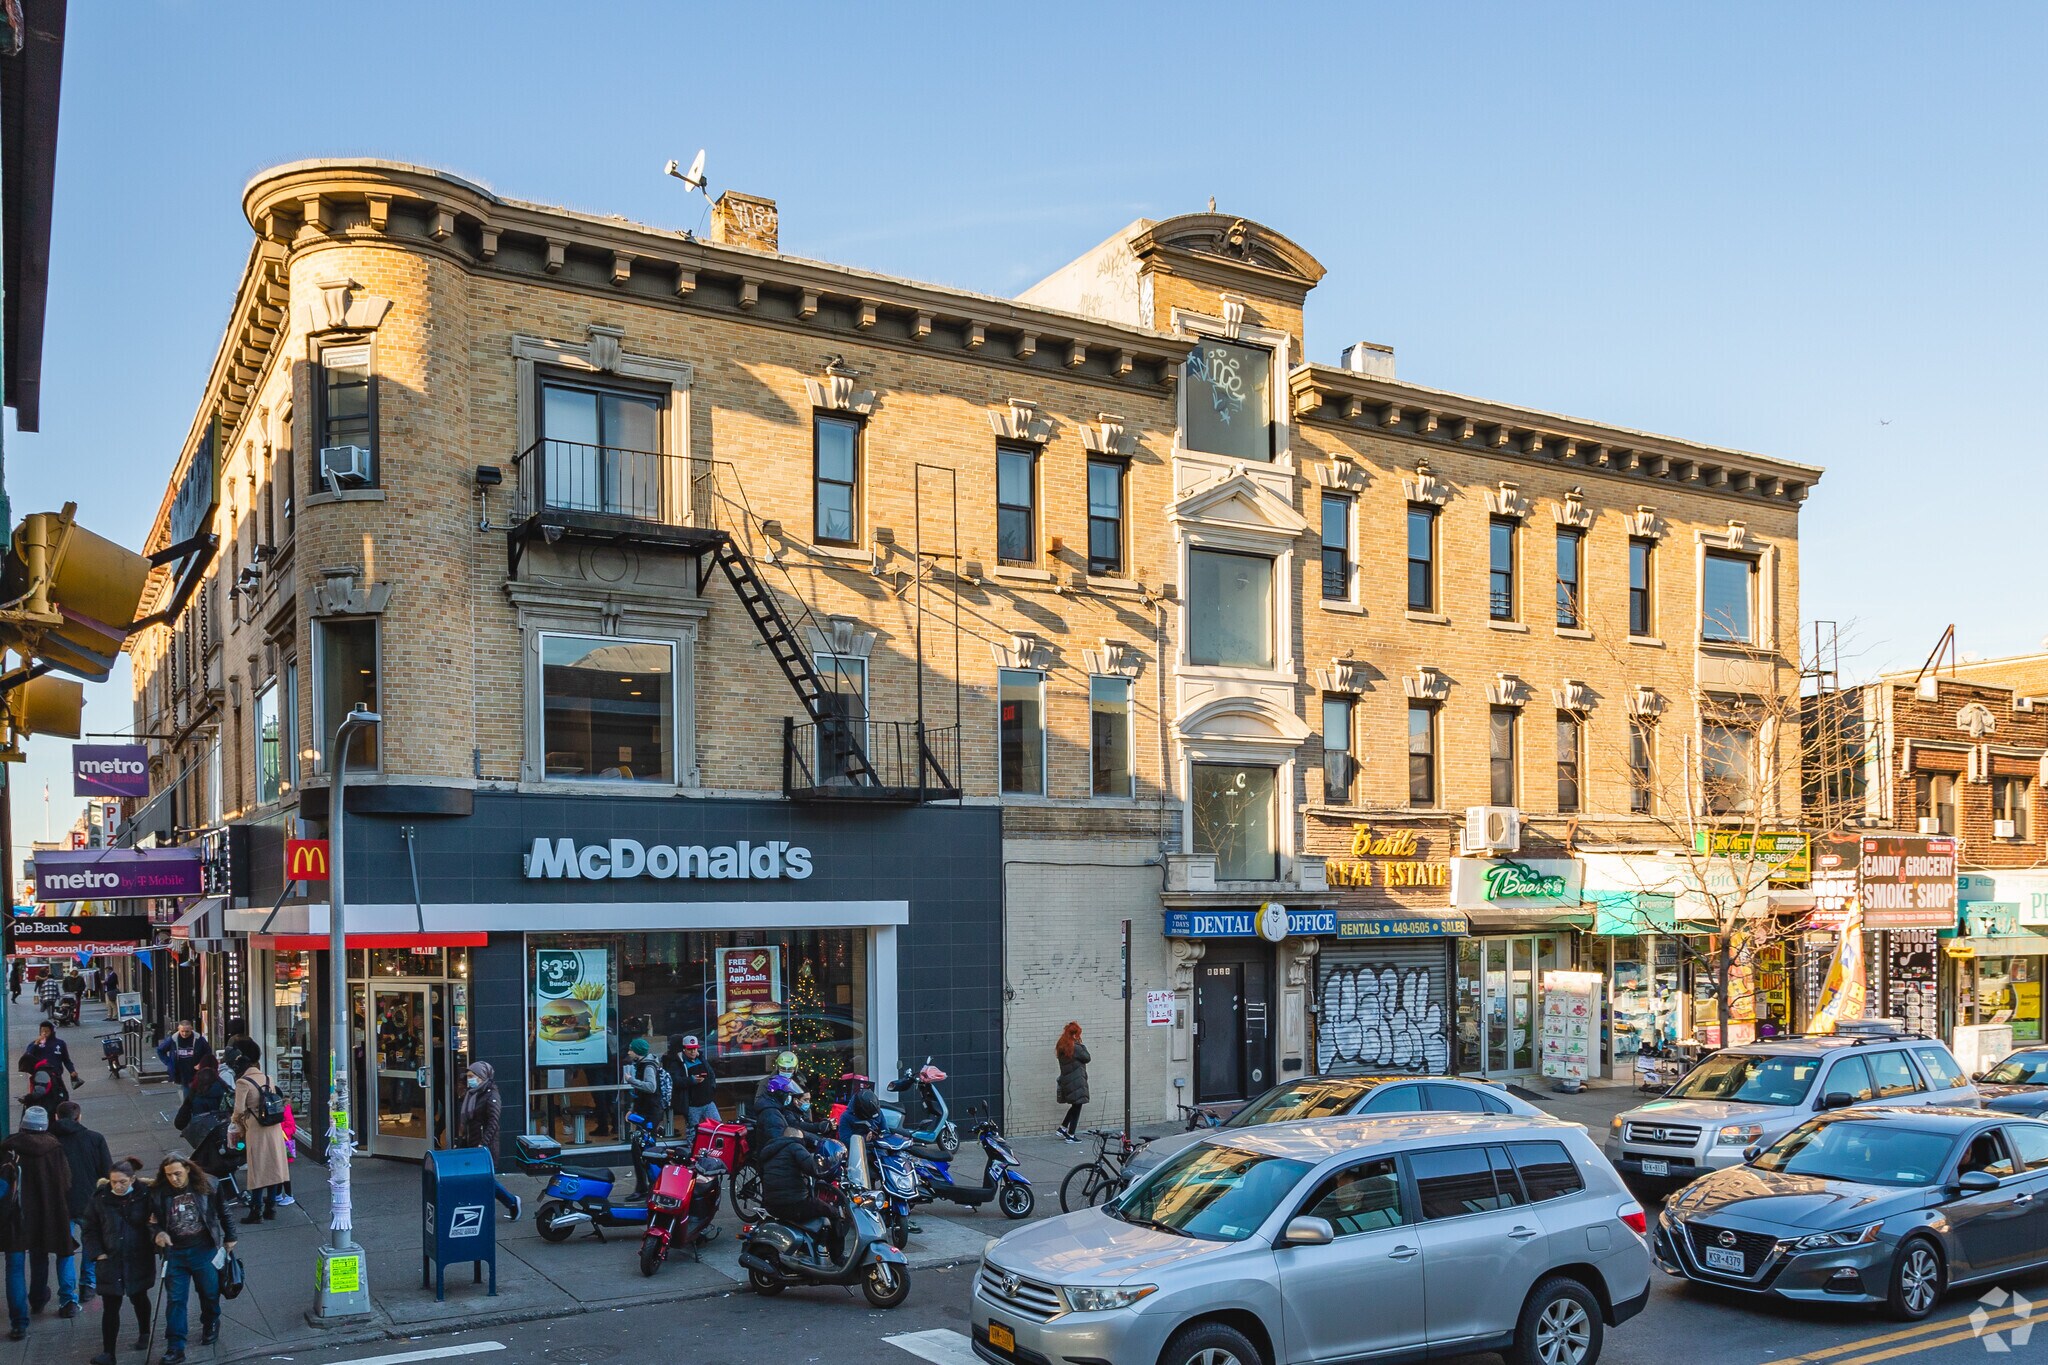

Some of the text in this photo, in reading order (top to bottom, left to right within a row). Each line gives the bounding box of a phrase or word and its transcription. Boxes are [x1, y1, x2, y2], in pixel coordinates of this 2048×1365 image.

[79, 758, 144, 774] metro
[1352, 823, 1418, 857] Basile
[527, 837, 813, 880] McDonald's
[1864, 856, 1900, 877] CANDY
[1905, 856, 1953, 877] GROCERY
[44, 870, 120, 889] metro
[148, 874, 185, 886] Mobile
[1384, 861, 1447, 886] ESTATE
[1864, 884, 1953, 908] SMOKE SHOP
[33, 922, 69, 933] Bank
[1194, 913, 1334, 934] DENTAL OFFICE
[1341, 921, 1466, 935] RENTALS 449-0505 SALES
[1893, 931, 1934, 943] SMOKE
[35, 944, 82, 953] Personal
[84, 944, 134, 954] Checking
[1893, 943, 1933, 953] SHOP
[728, 967, 748, 975] Daily
[729, 973, 767, 984] App Deals
